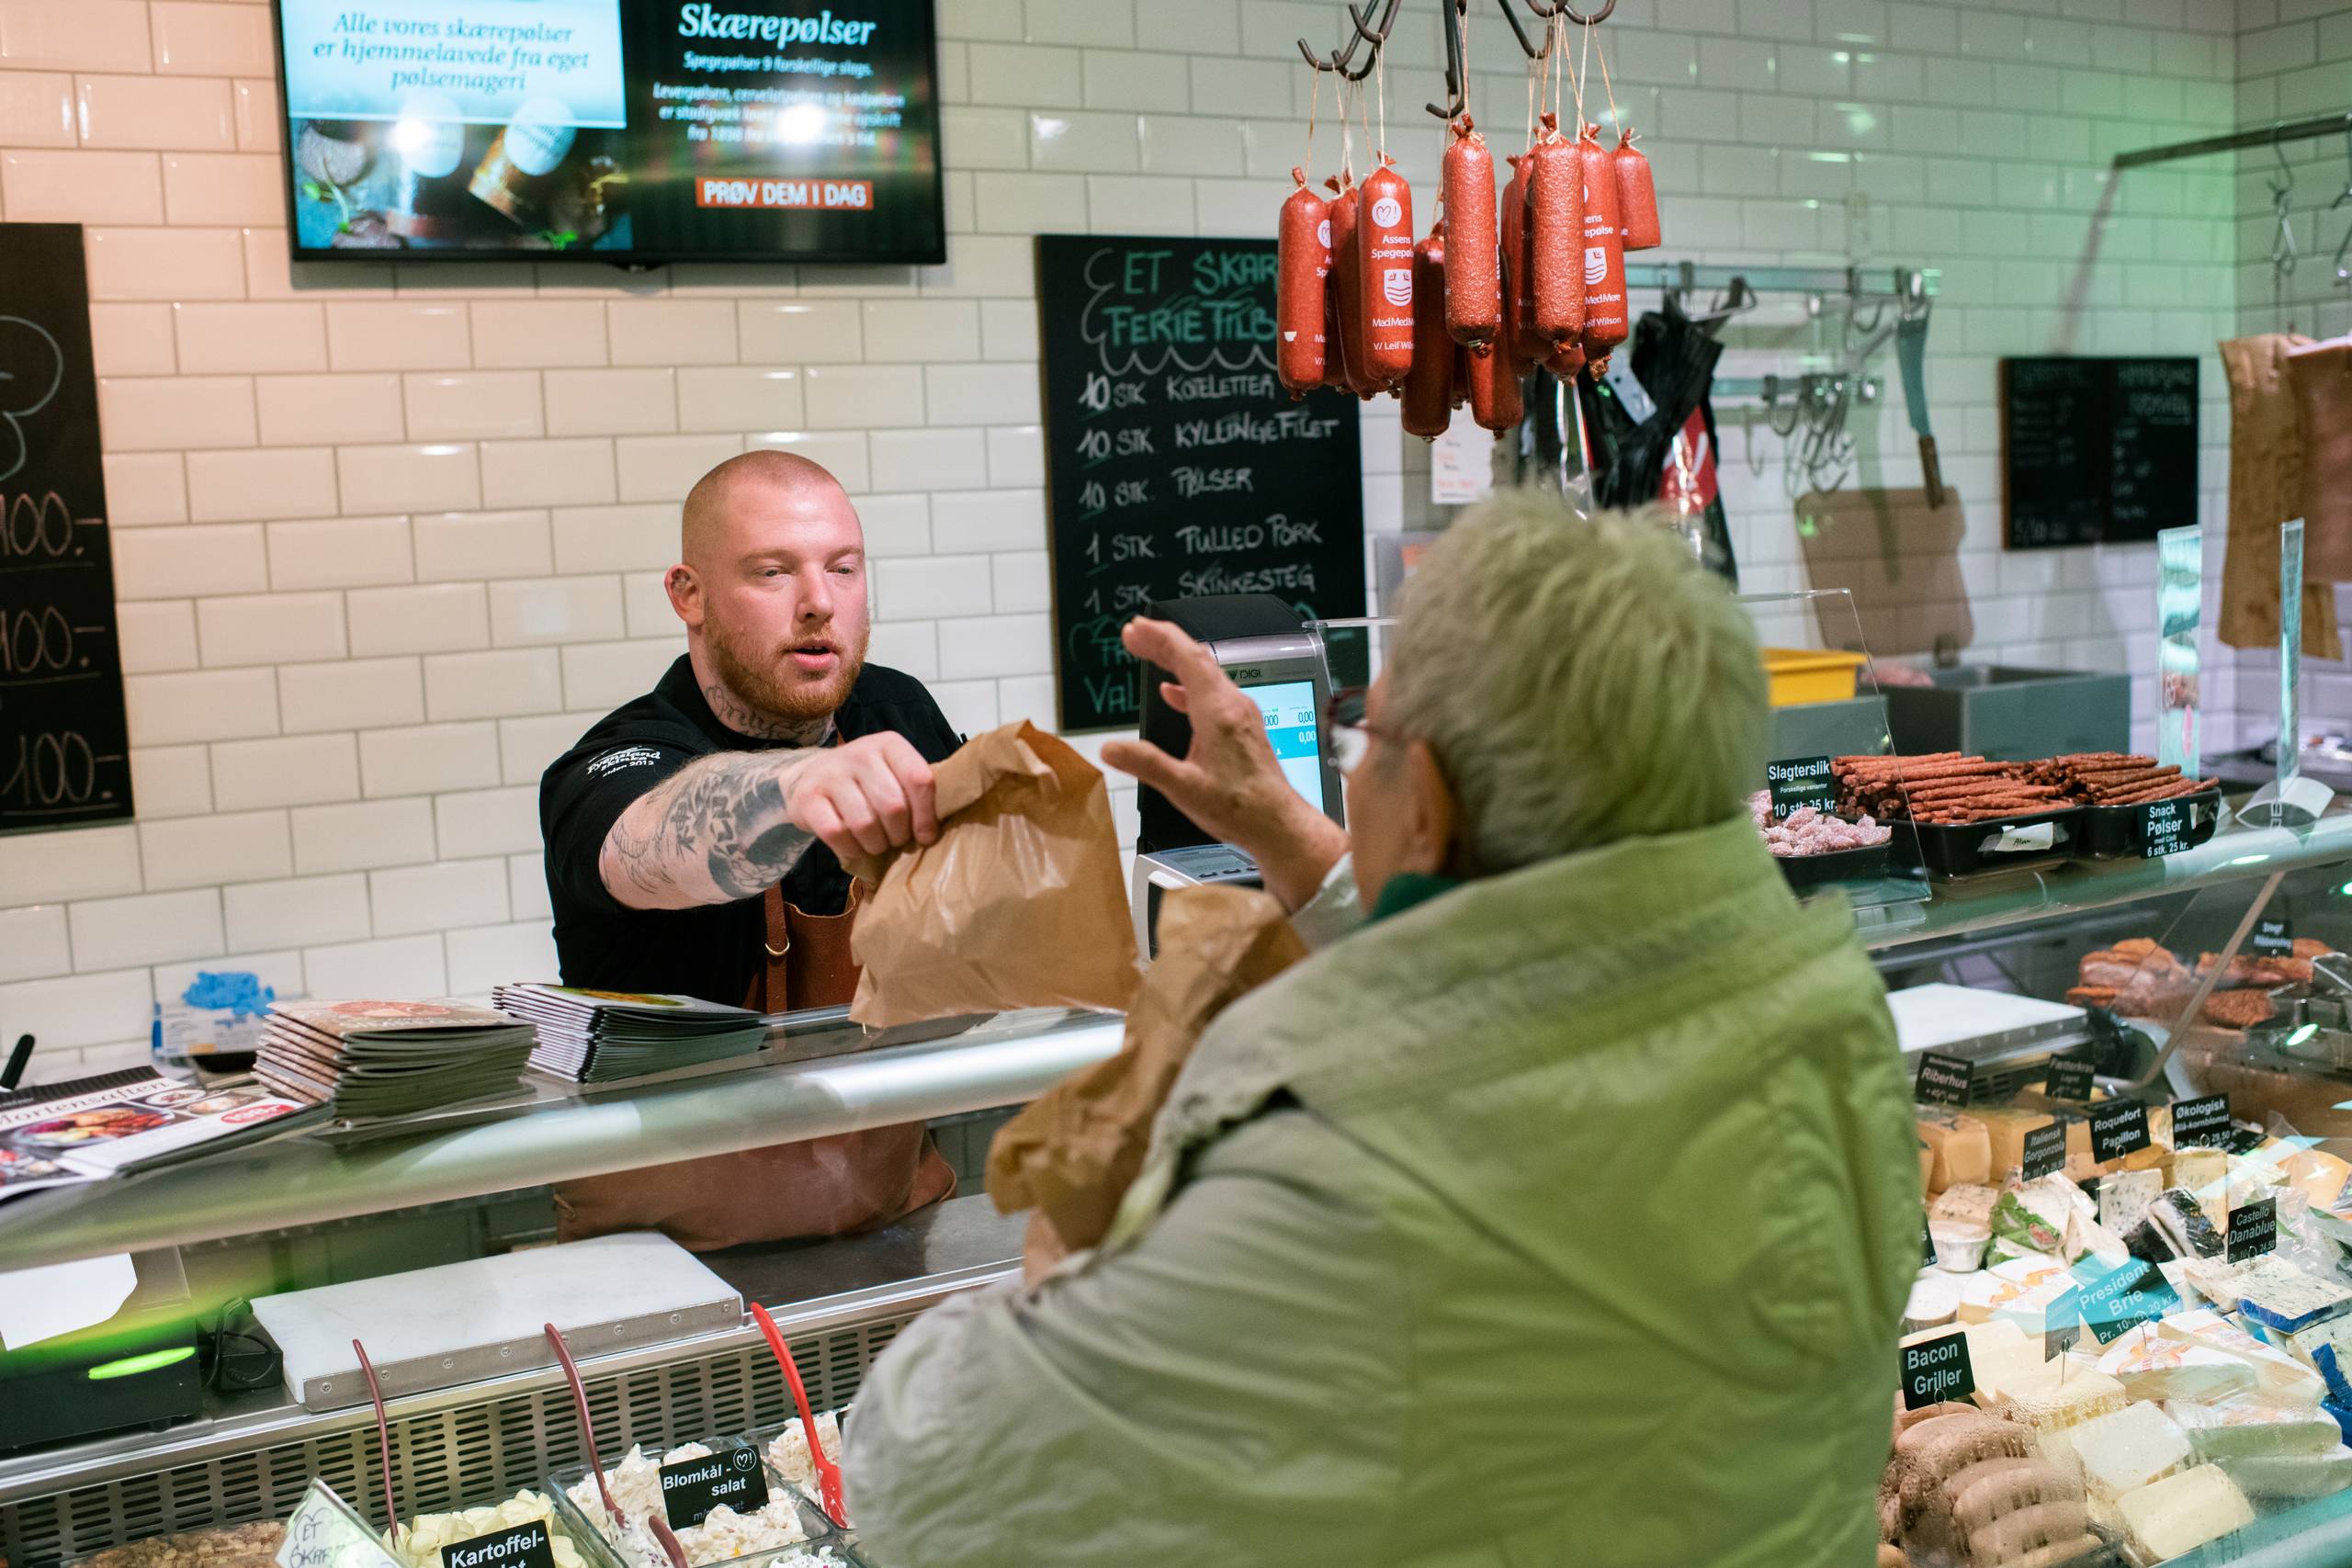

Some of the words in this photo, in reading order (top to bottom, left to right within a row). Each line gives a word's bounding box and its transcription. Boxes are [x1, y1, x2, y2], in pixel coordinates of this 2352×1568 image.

[333, 13, 377, 33] Alle
[383, 20, 439, 37] vores
[447, 17, 574, 48] skærepølser
[678, 3, 876, 50] Skærepølser
[312, 41, 336, 57] er
[343, 39, 506, 65] hjemmelavede
[510, 46, 542, 70] fra
[548, 51, 589, 72] eget
[391, 67, 526, 95] pølsemageri
[704, 181, 759, 205] PRØV
[763, 182, 807, 205] DEM
[812, 183, 820, 206] I
[824, 184, 866, 207] DAG
[1124, 250, 1173, 295] ET
[1193, 250, 1278, 295] SKAR
[1078, 371, 1112, 411] 10
[1077, 427, 1112, 458] 10
[1079, 479, 1106, 511] 10
[1085, 532, 1101, 564] 1
[1263, 513, 1323, 547] PORK
[1084, 587, 1101, 615] 1
[1084, 671, 1140, 714] VAL
[1298, 711, 1314, 723] 0,00
[1298, 731, 1316, 744] 0,00
[1769, 761, 1830, 781] Slagterslik
[1774, 803, 1786, 817] 10
[2150, 803, 2176, 818] Snack
[2147, 819, 2183, 837] Pølser
[2147, 846, 2153, 857] 6
[2154, 844, 2166, 855] stk.
[2169, 841, 2178, 852] 25
[1921, 1066, 1968, 1089] Riberhus
[2095, 1107, 2141, 1133] Roquefort
[2176, 1098, 2225, 1119] Økologisk
[2030, 1127, 2061, 1146] Italiensk
[2102, 1129, 2141, 1150] Papillon
[2024, 1139, 2064, 1162] Gorgonzola
[2236, 1206, 2269, 1226] Castello
[2229, 1220, 2276, 1245] Danablue
[2079, 1260, 2150, 1310] President
[2109, 1289, 2143, 1315] Brie
[2099, 1331, 2115, 1344] Pr.
[2148, 1303, 2160, 1314] 20
[2162, 1295, 2177, 1305] kr.
[1907, 1343, 1958, 1370] Bacon
[1915, 1369, 1962, 1394] Griller
[663, 1464, 722, 1490] Blomkål
[711, 1477, 746, 1496] salat
[452, 1529, 545, 1568] Kartoffel-
